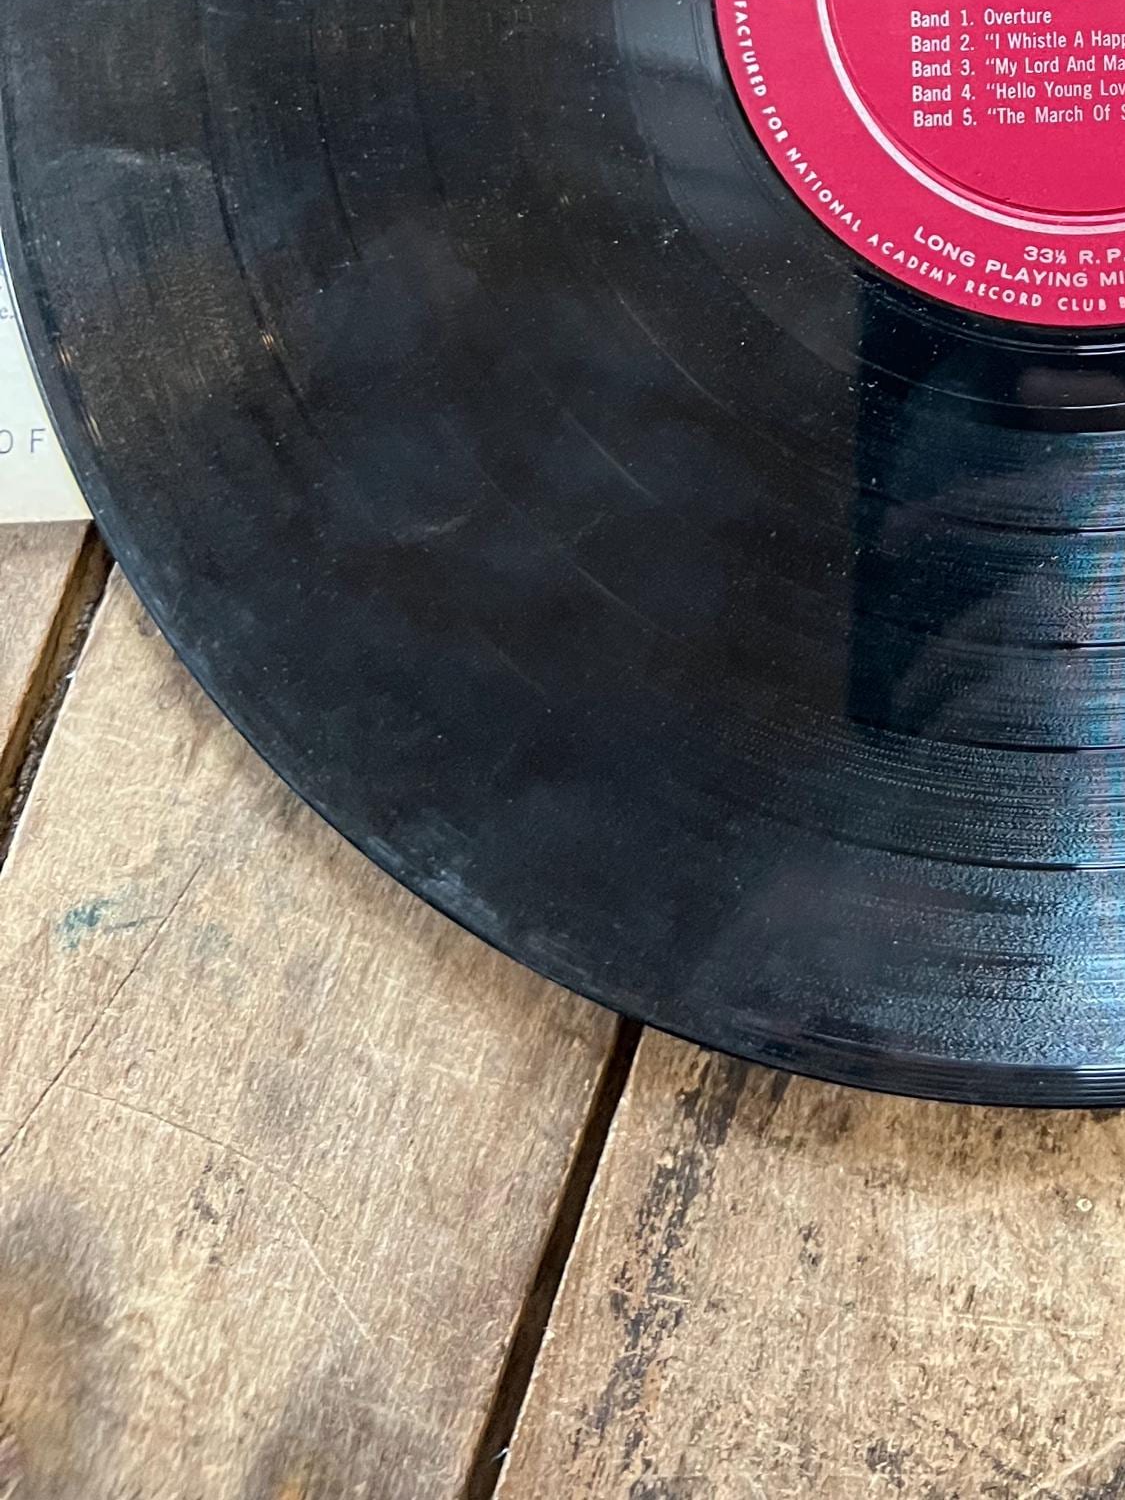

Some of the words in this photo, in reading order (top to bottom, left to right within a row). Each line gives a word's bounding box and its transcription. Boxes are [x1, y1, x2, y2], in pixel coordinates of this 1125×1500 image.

[910, 9, 950, 28] Band
[960, 9, 974, 27] 1.
[983, 8, 1052, 26] Overture
[911, 34, 951, 53] Band
[959, 33, 975, 52] 2.
[1007, 31, 1067, 50] Whistle
[1073, 30, 1084, 48] A
[911, 59, 952, 78] Band
[960, 58, 976, 76] 3.
[1024, 55, 1060, 74] Lord
[1066, 55, 1096, 73] And
[912, 84, 952, 103] Band
[960, 83, 976, 101] 4.
[1043, 81, 1093, 100] Young
[913, 109, 953, 128] Band
[962, 107, 977, 126] 5.
[1035, 105, 1083, 123] March
[1093, 103, 1111, 122] Of
[762, 106, 789, 143] FOR
[786, 147, 863, 233] NATIONAL
[867, 233, 957, 286] ACADEMY
[965, 279, 1042, 307] RECORD
[1057, 297, 1107, 312] CLUB
[914, 226, 976, 268] LONG
[985, 259, 1088, 288] PLAYING
